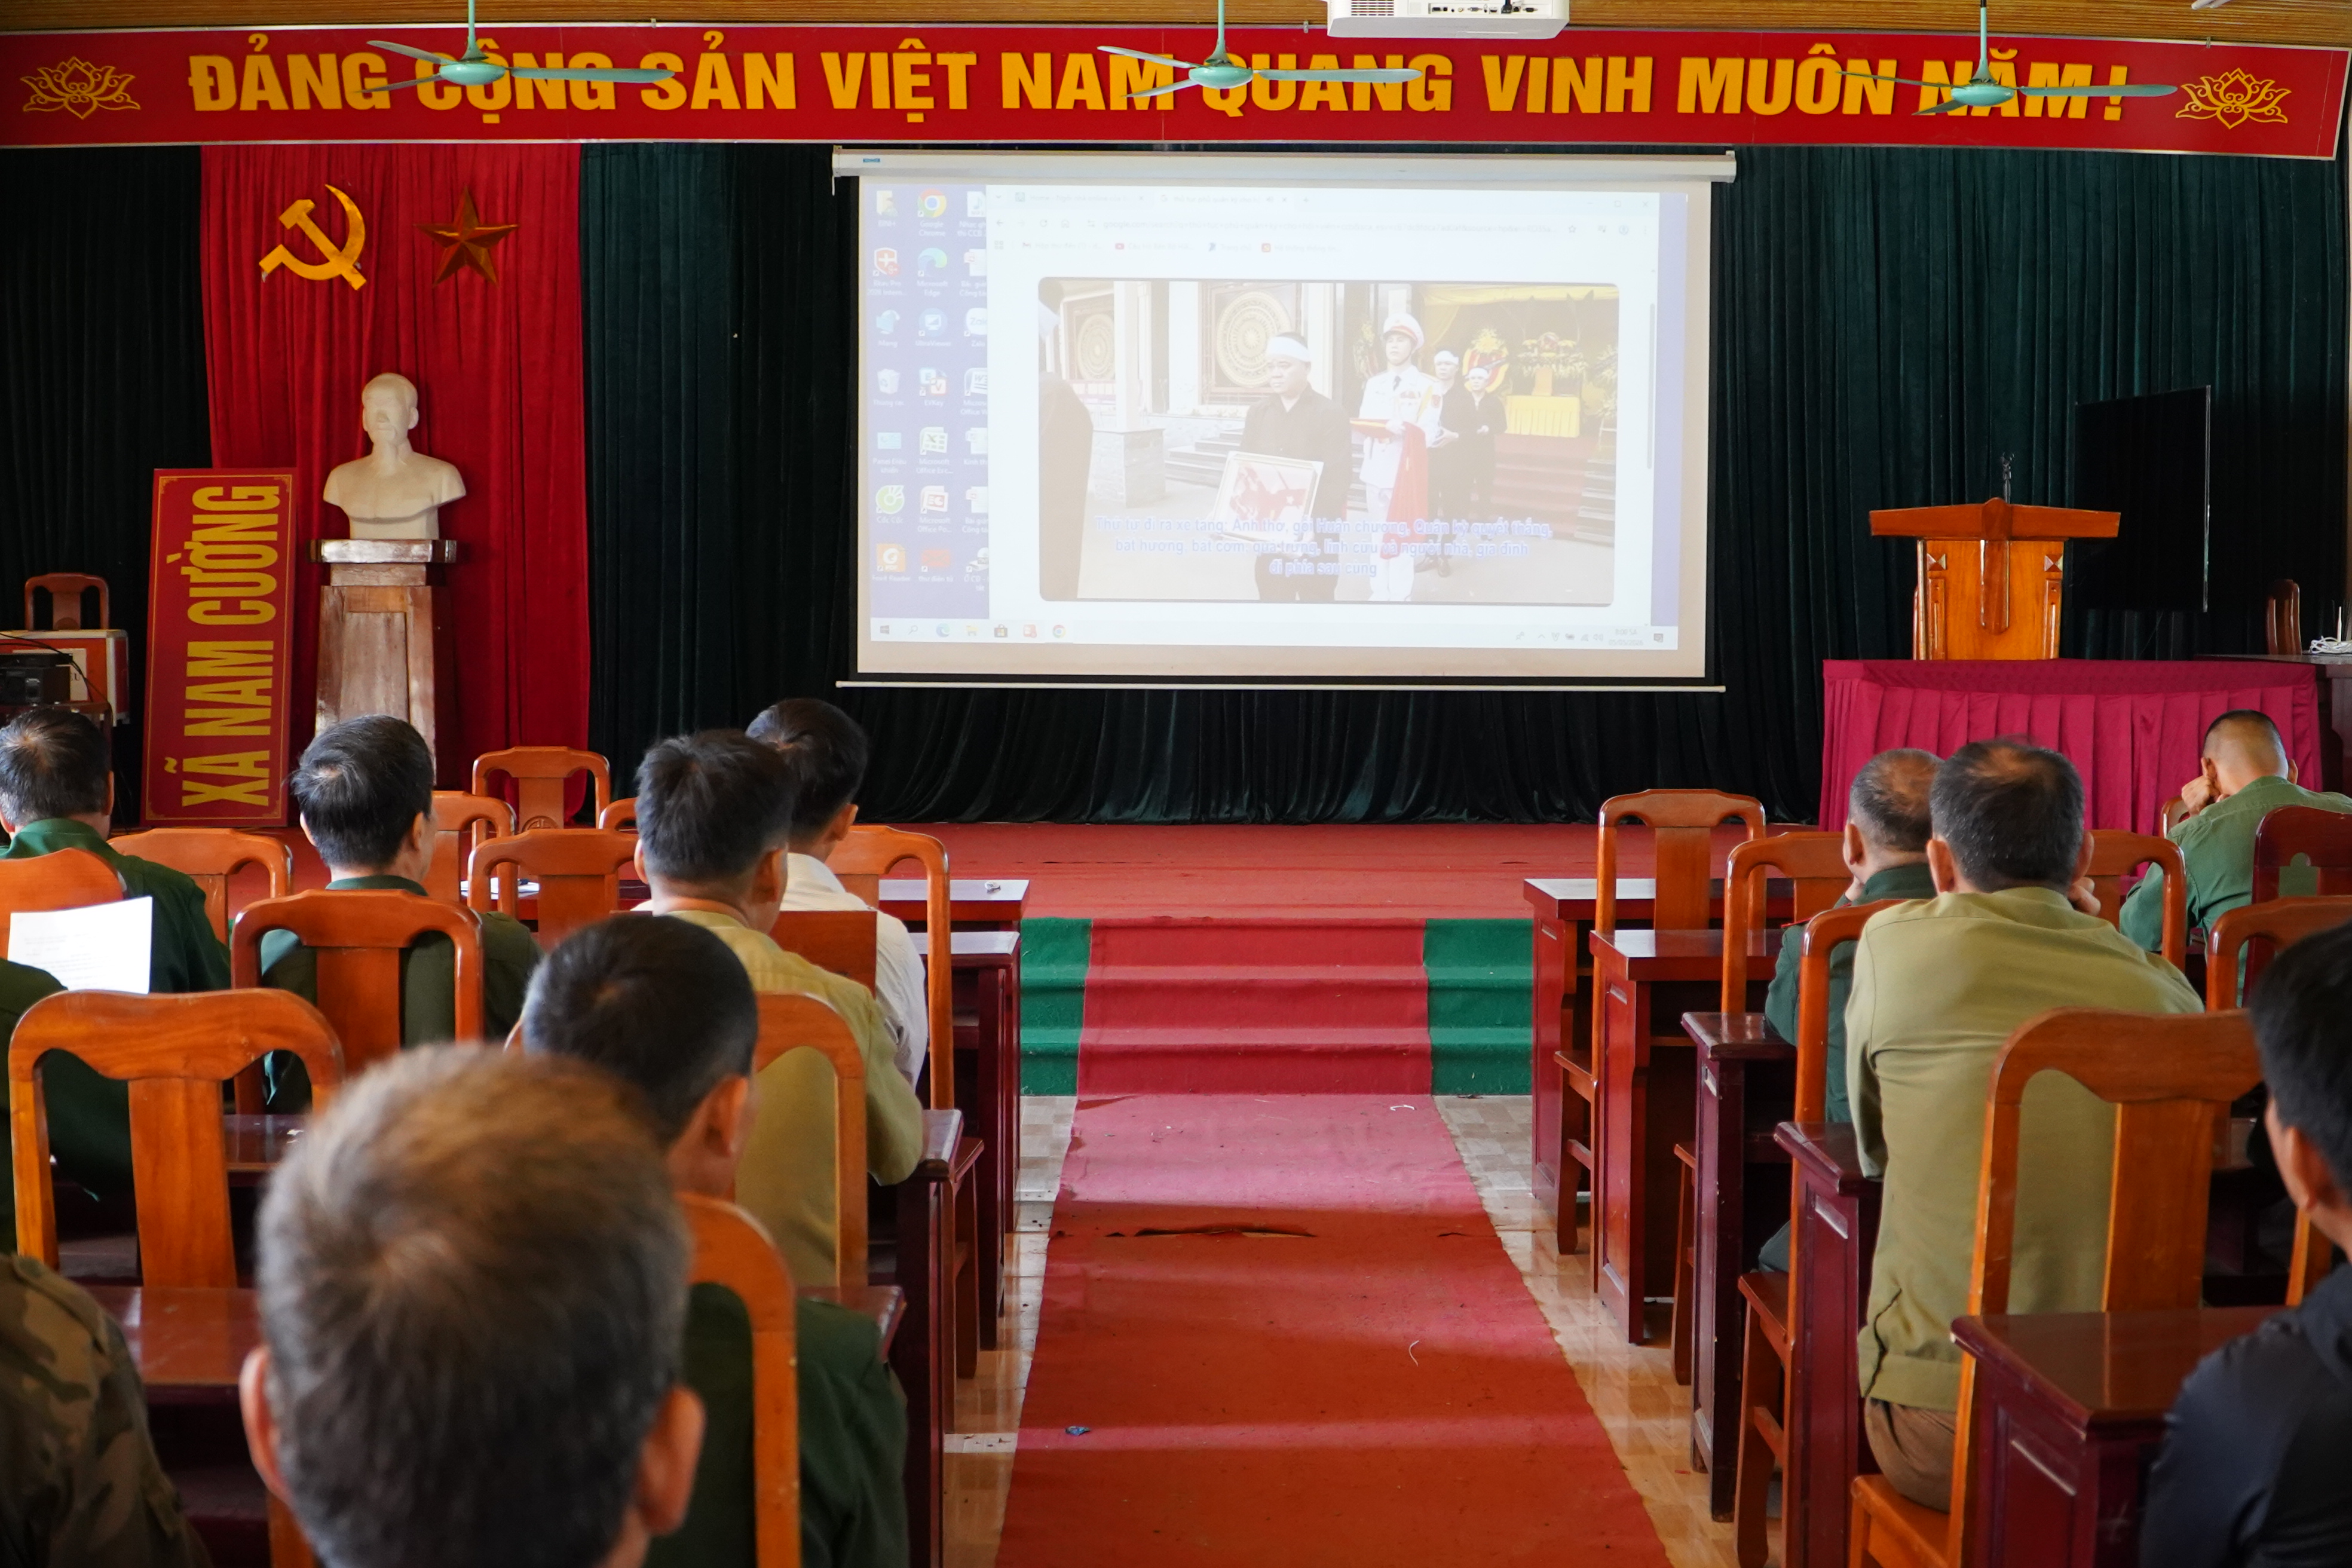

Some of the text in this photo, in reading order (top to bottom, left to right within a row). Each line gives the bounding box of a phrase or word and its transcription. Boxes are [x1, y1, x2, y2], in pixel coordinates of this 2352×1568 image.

[188, 33, 390, 112] ĐẢNG
[415, 38, 615, 124] CỘNG
[639, 30, 797, 111] SẢN
[820, 38, 977, 123] VIỆT
[1001, 52, 1174, 111] NAM
[1202, 53, 1453, 117] QUANG
[1481, 55, 1653, 114] VINH
[1677, 43, 1897, 116] MUÔN
[1919, 47, 2093, 120] NĂM
[1144, 517, 1156, 531] đi
[1160, 520, 1172, 531] ra
[1176, 520, 1191, 531] xe
[1316, 517, 1350, 532] Huân
[1414, 519, 1450, 535] Quân
[1471, 516, 1509, 538] quyết
[1476, 542, 1496, 559] gia
[1500, 541, 1529, 555] đình
[1269, 558, 1377, 578] đi phía sau cùng
[164, 485, 281, 807] XÃ NAM CƯỜNG
